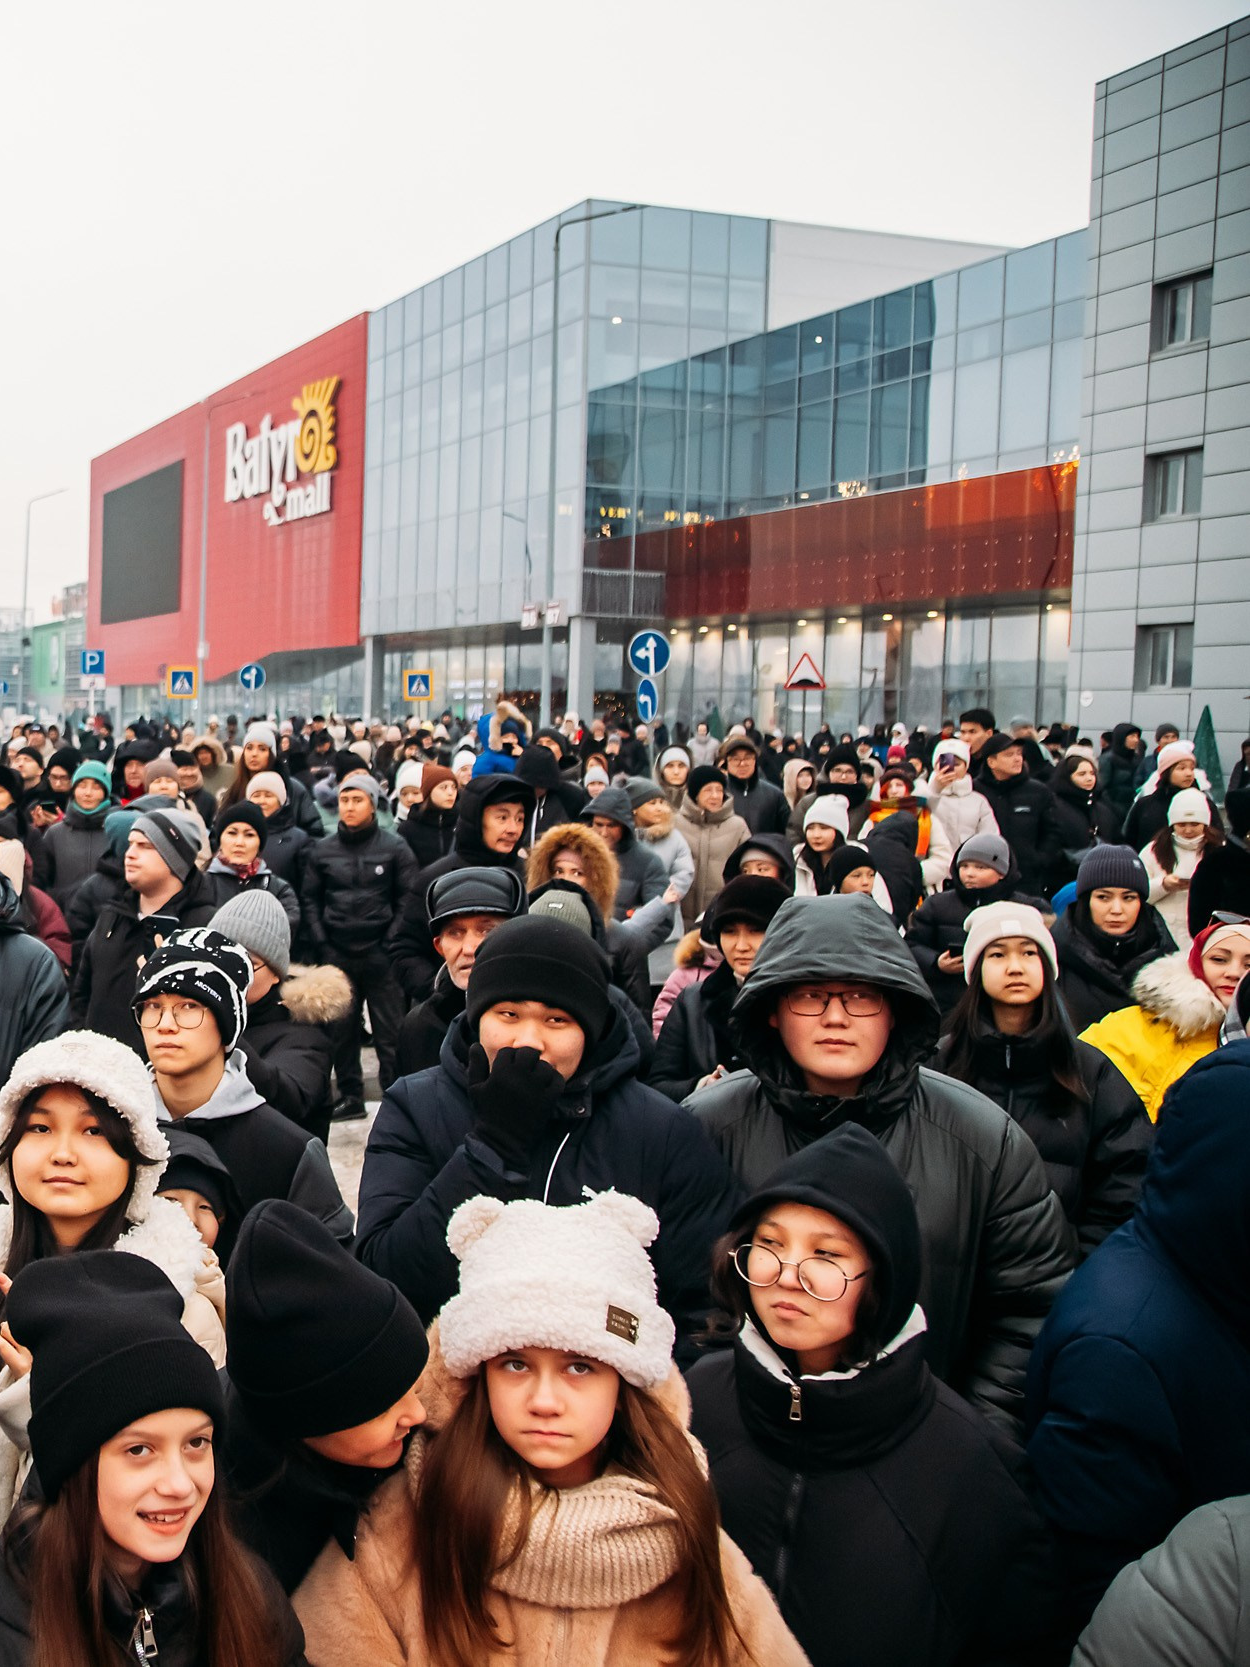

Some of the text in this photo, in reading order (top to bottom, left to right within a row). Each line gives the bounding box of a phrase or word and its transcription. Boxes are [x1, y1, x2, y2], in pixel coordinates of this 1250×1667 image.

[224, 412, 302, 508] Batyr
[285, 472, 331, 522] mall
[86, 651, 100, 673] P
